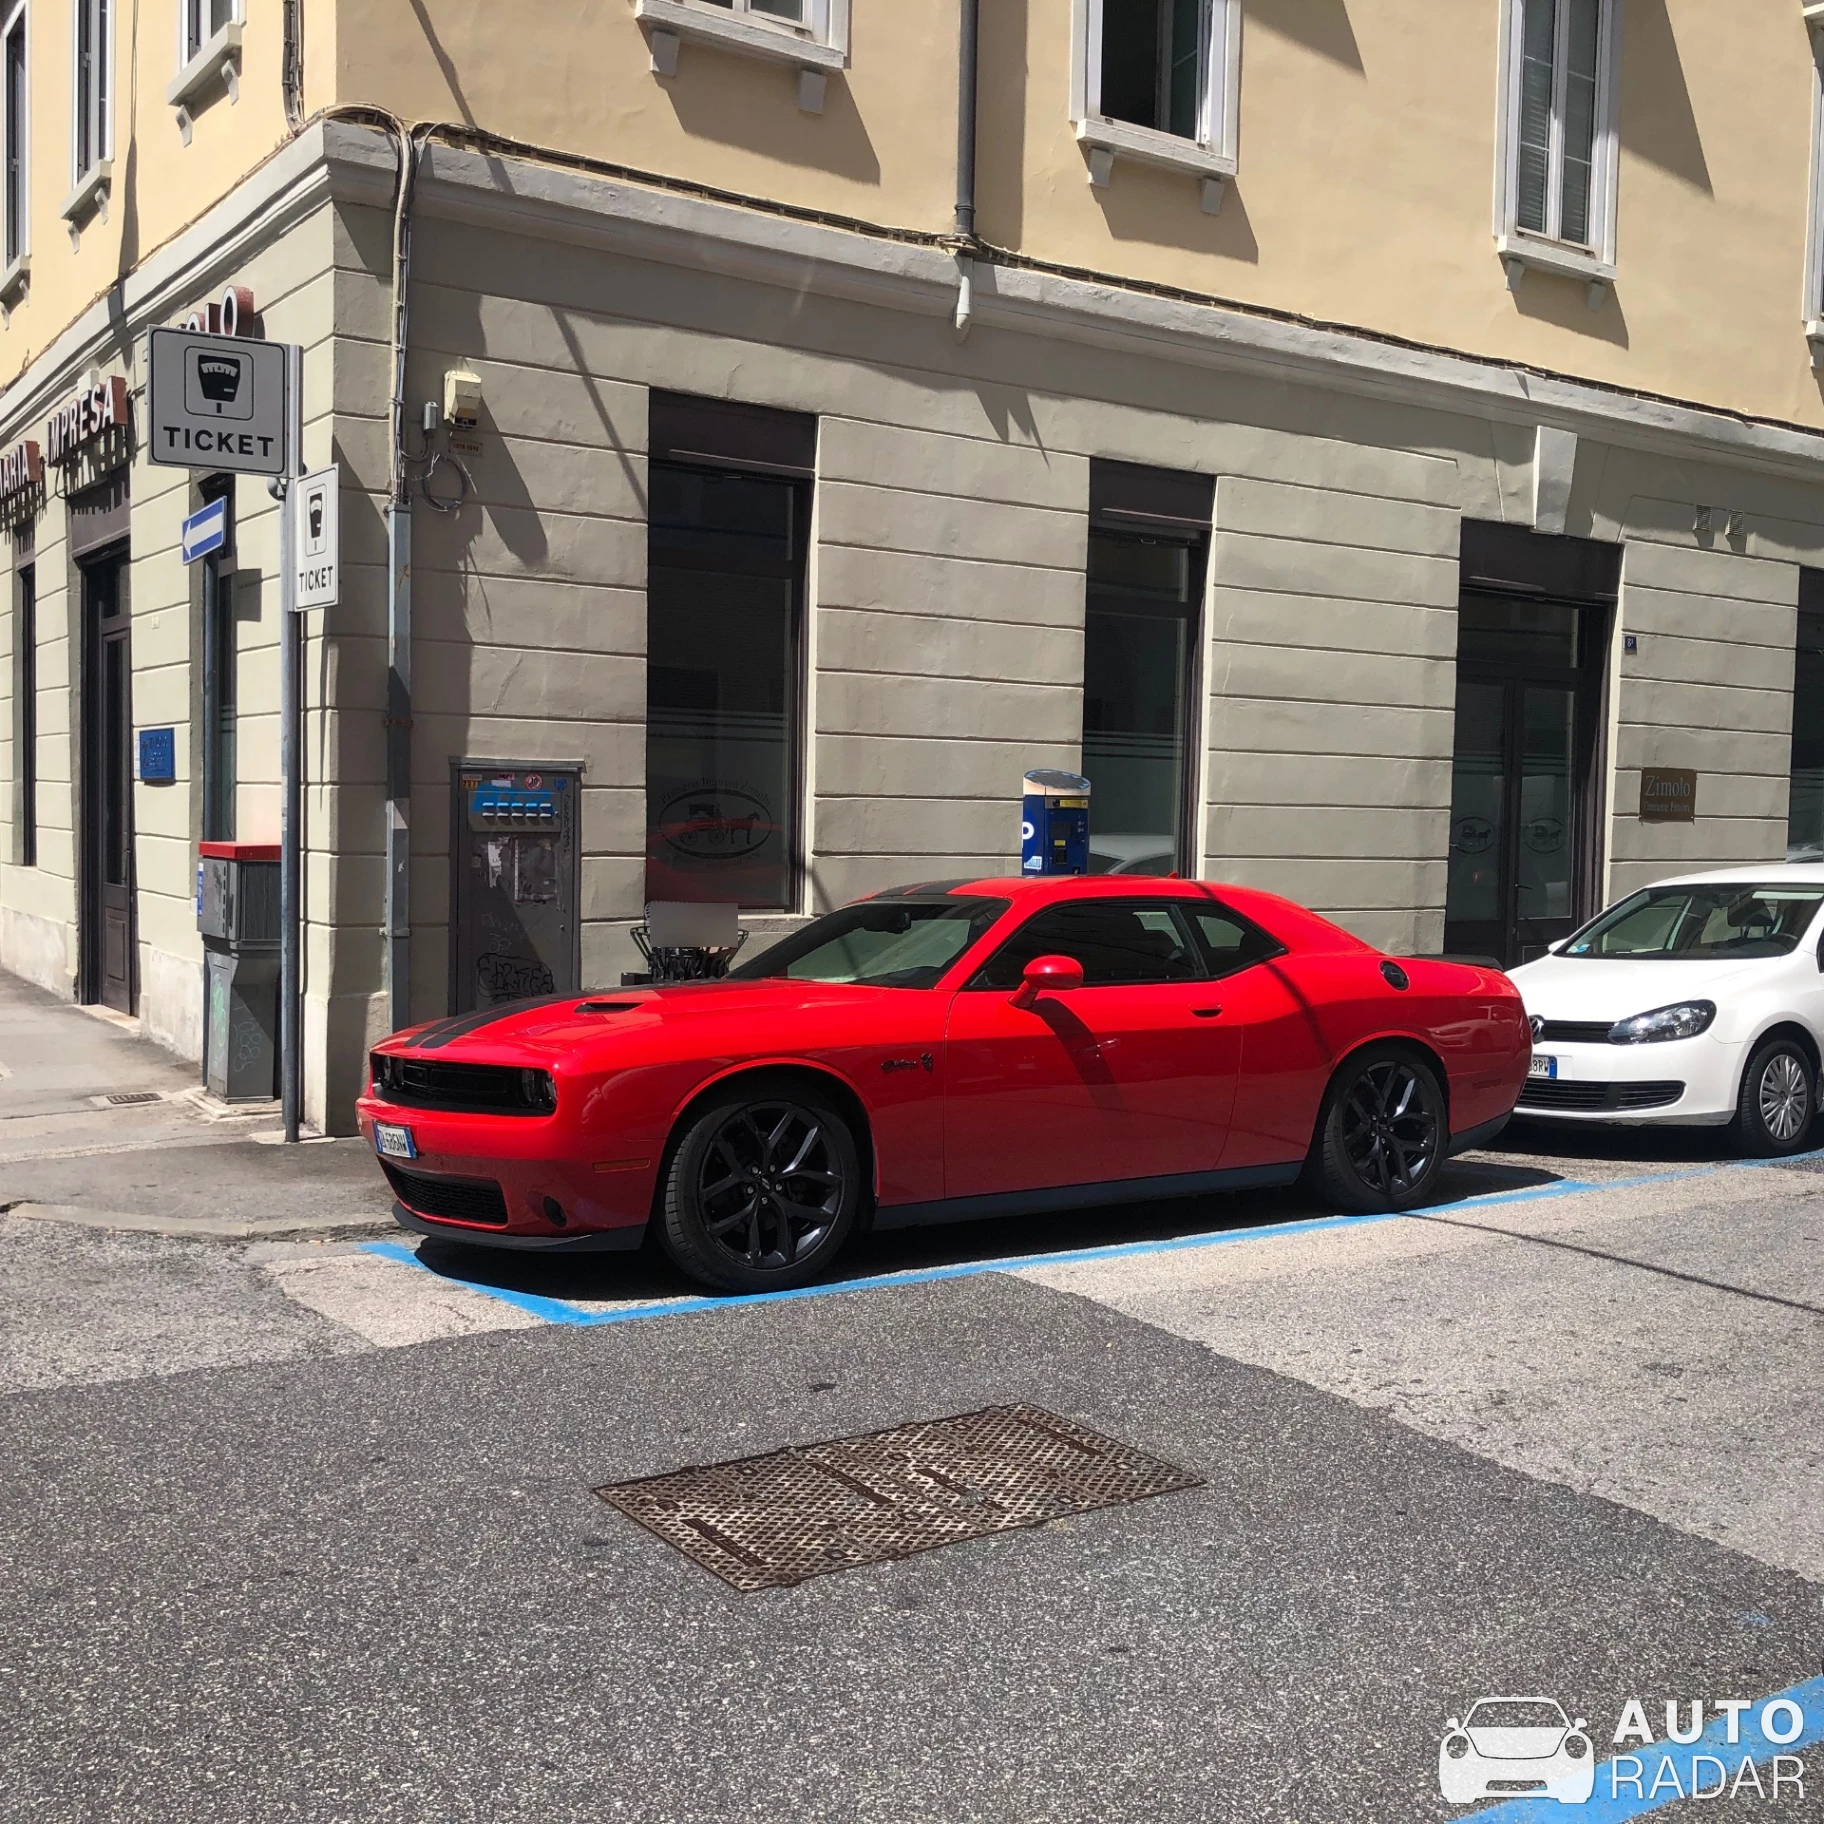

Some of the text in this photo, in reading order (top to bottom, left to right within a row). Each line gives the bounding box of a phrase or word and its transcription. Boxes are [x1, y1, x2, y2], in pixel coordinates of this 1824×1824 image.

[47, 376, 117, 466] IMPRESA
[163, 426, 274, 457] TICKET
[299, 566, 333, 592] TICKET
[1645, 775, 1691, 796] Zimolo
